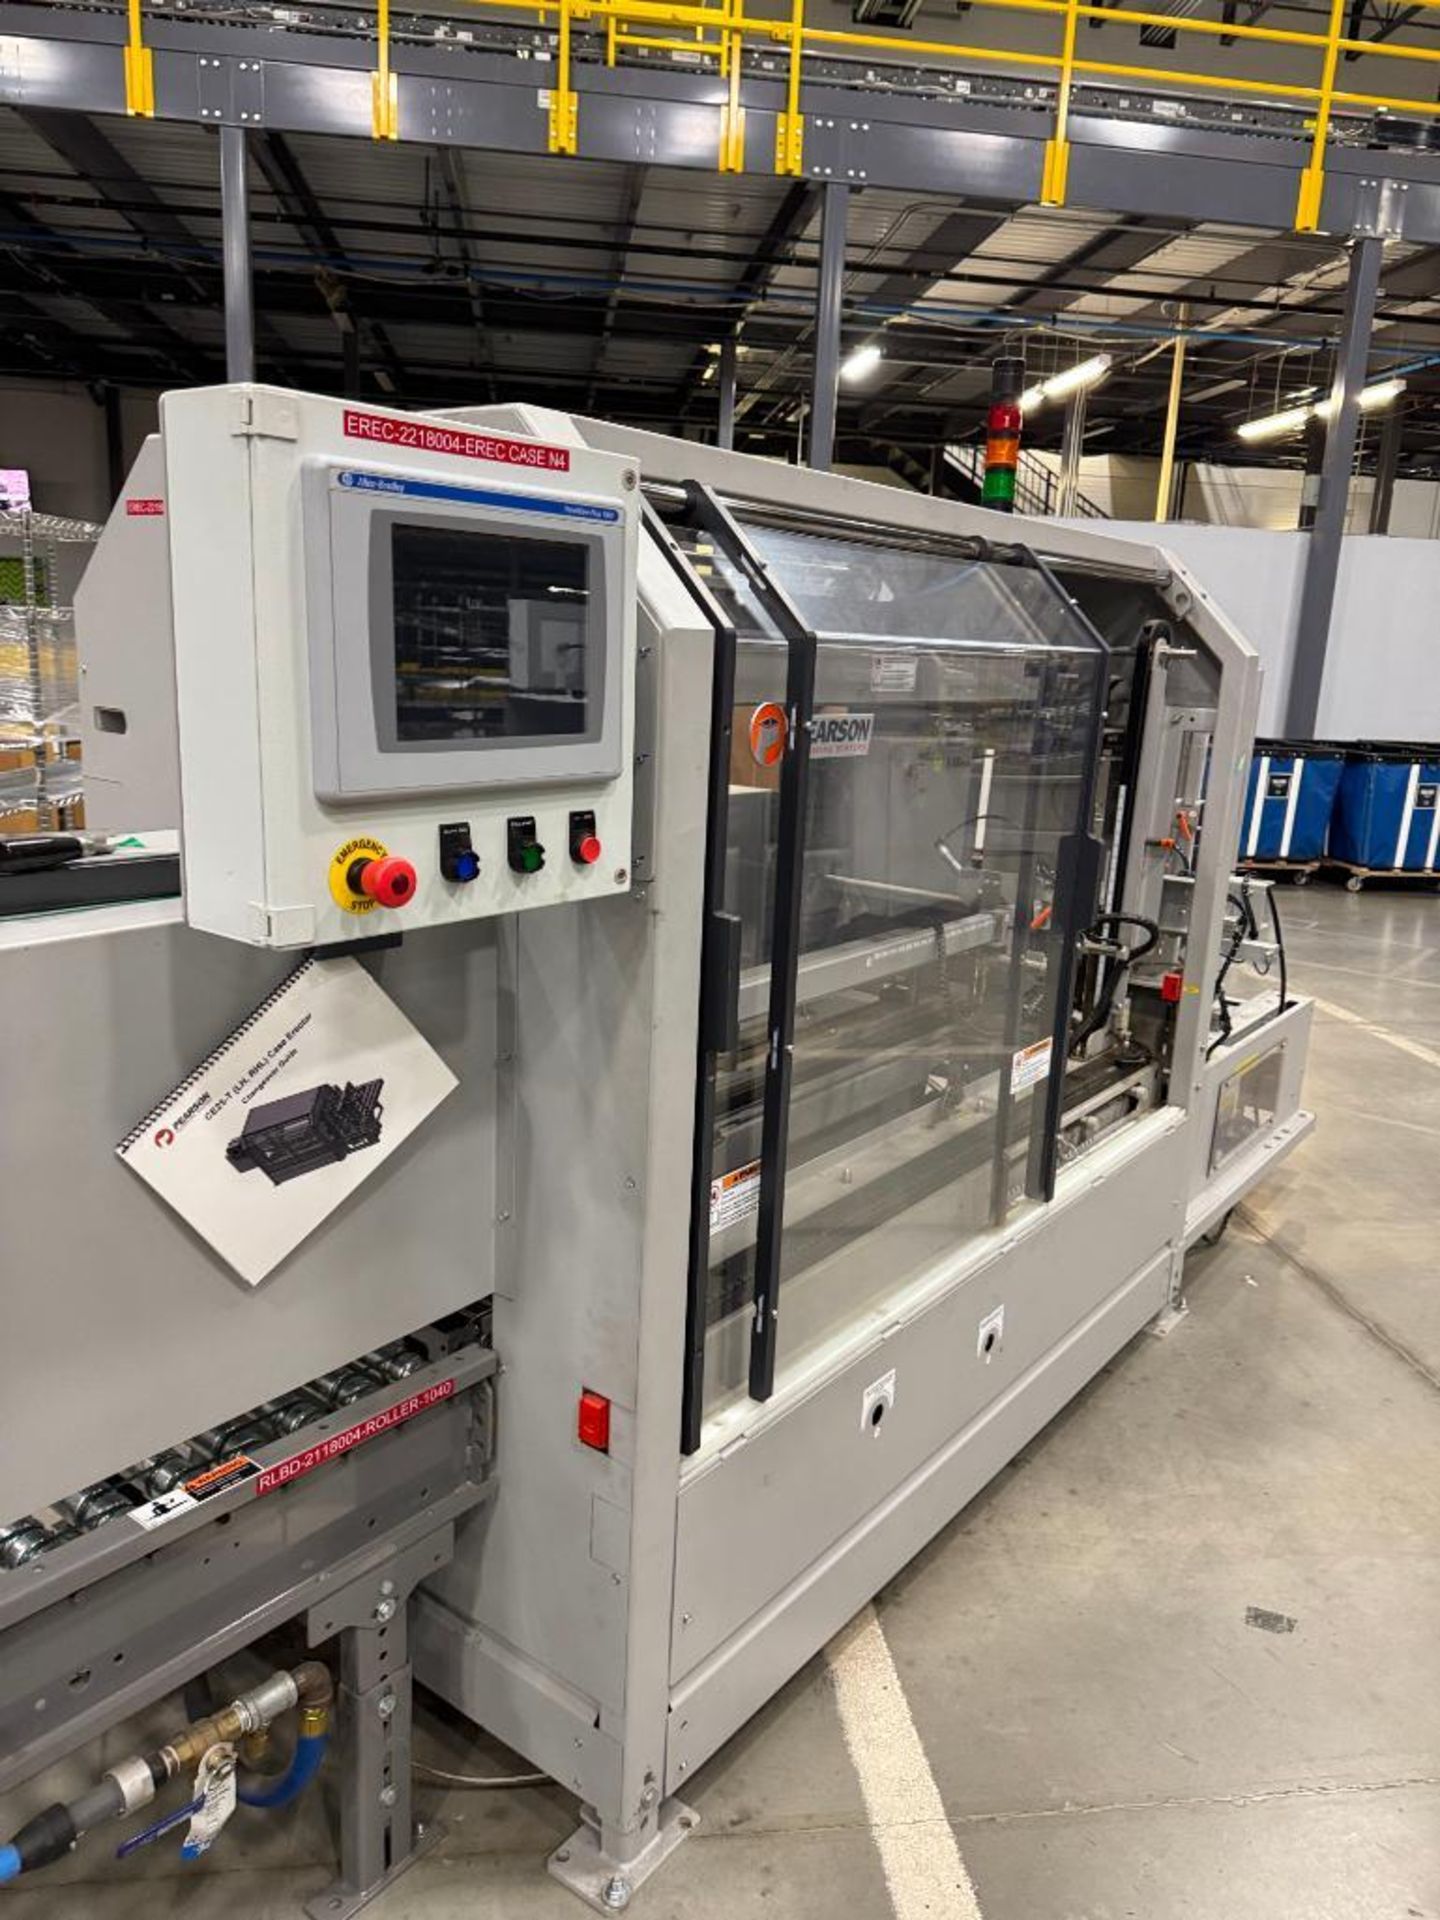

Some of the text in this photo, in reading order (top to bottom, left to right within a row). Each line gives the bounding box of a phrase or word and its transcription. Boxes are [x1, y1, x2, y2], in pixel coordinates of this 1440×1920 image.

[347, 415, 567, 468] EREC-2218004-EREC CASE N4
[808, 718, 872, 743] EARSON
[336, 838, 388, 864] EMERGENCY
[266, 1039, 287, 1059] Case
[172, 1091, 211, 1130] PEARSON
[259, 1382, 452, 1492] RLBD-2118004-ROLLER-1040
